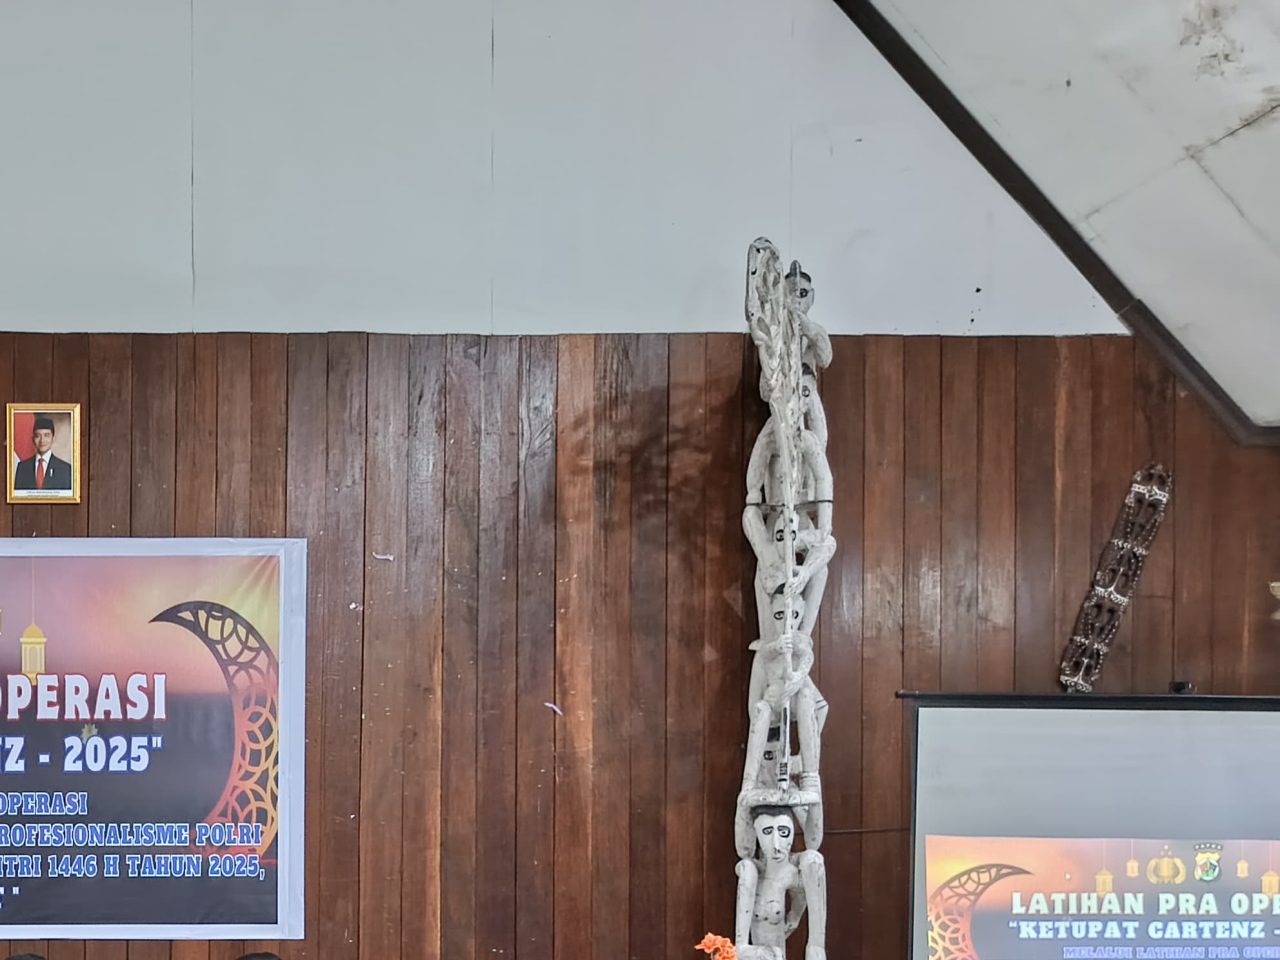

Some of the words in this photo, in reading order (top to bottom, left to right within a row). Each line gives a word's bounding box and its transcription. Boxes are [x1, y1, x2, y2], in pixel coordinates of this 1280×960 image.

[195, 822, 263, 847] POLRI
[47, 854, 98, 878] 1446
[103, 854, 121, 878] H
[126, 854, 203, 878] TAHUN
[207, 854, 266, 881] 2025,
[1011, 892, 1145, 916] LATIHAN
[1158, 892, 1219, 916] PRA
[1147, 920, 1266, 940] CARTENZ
